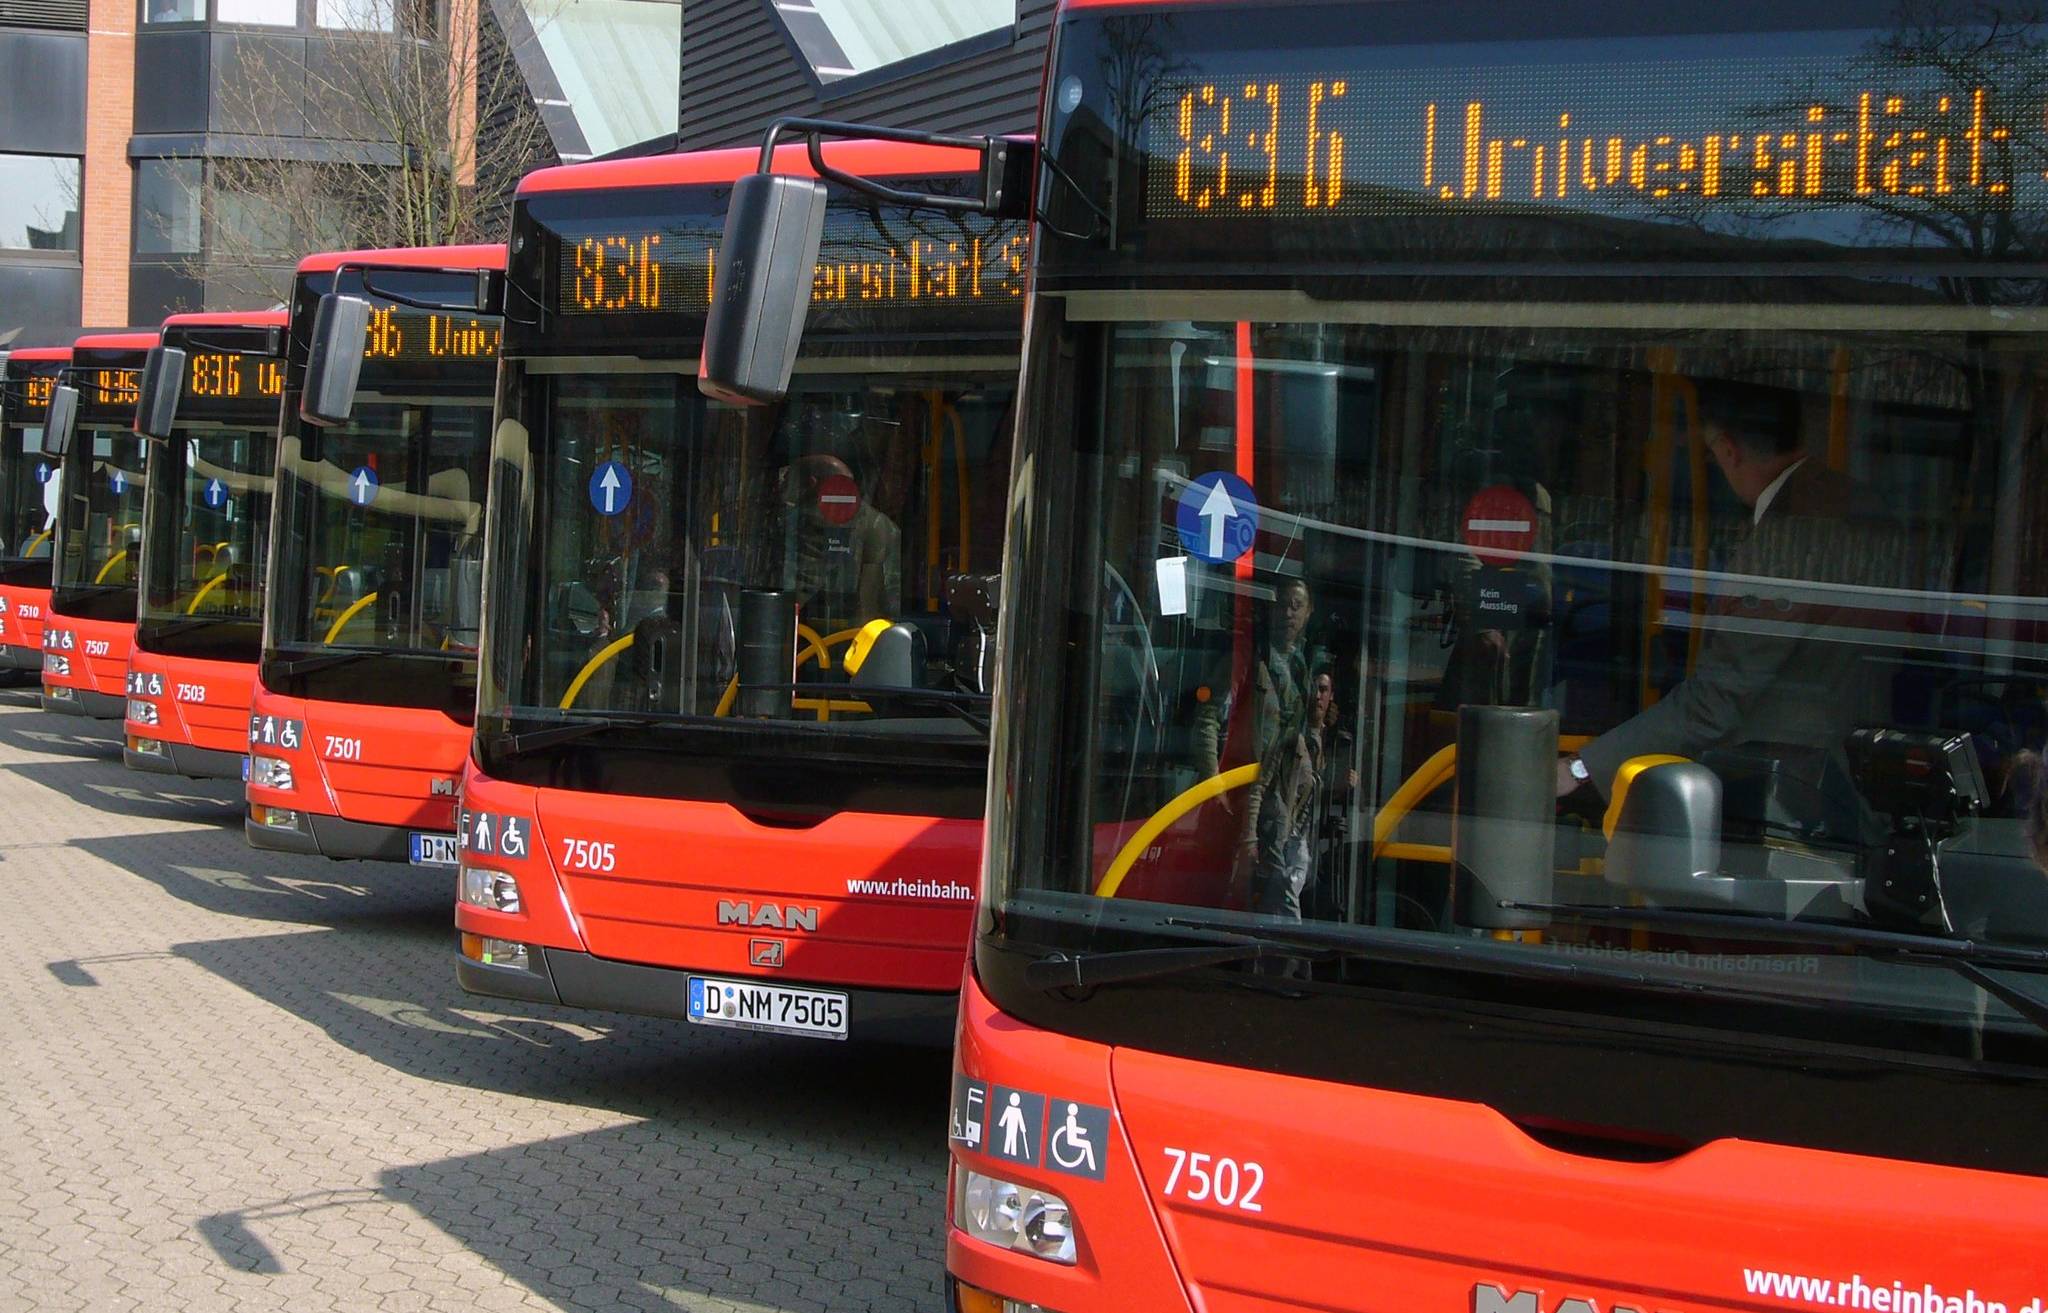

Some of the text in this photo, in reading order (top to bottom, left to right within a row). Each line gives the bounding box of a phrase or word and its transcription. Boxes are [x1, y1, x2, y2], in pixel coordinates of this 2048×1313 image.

[1176, 81, 2010, 208] 836 Universität
[577, 236, 661, 308] 836
[193, 355, 240, 395] 836
[1480, 588, 1500, 599] Kein
[18, 604, 39, 618] 7510
[1480, 601, 1518, 613] Ausstieg
[85, 640, 109, 655] 7507
[177, 684, 205, 702] 7503
[325, 736, 361, 760] 7501
[431, 778, 464, 797] M
[422, 838, 434, 859] D
[563, 838, 616, 872] 7505
[717, 901, 818, 931] MAN
[706, 985, 843, 1028] D NM 7505
[1163, 1147, 1264, 1212] 7502
